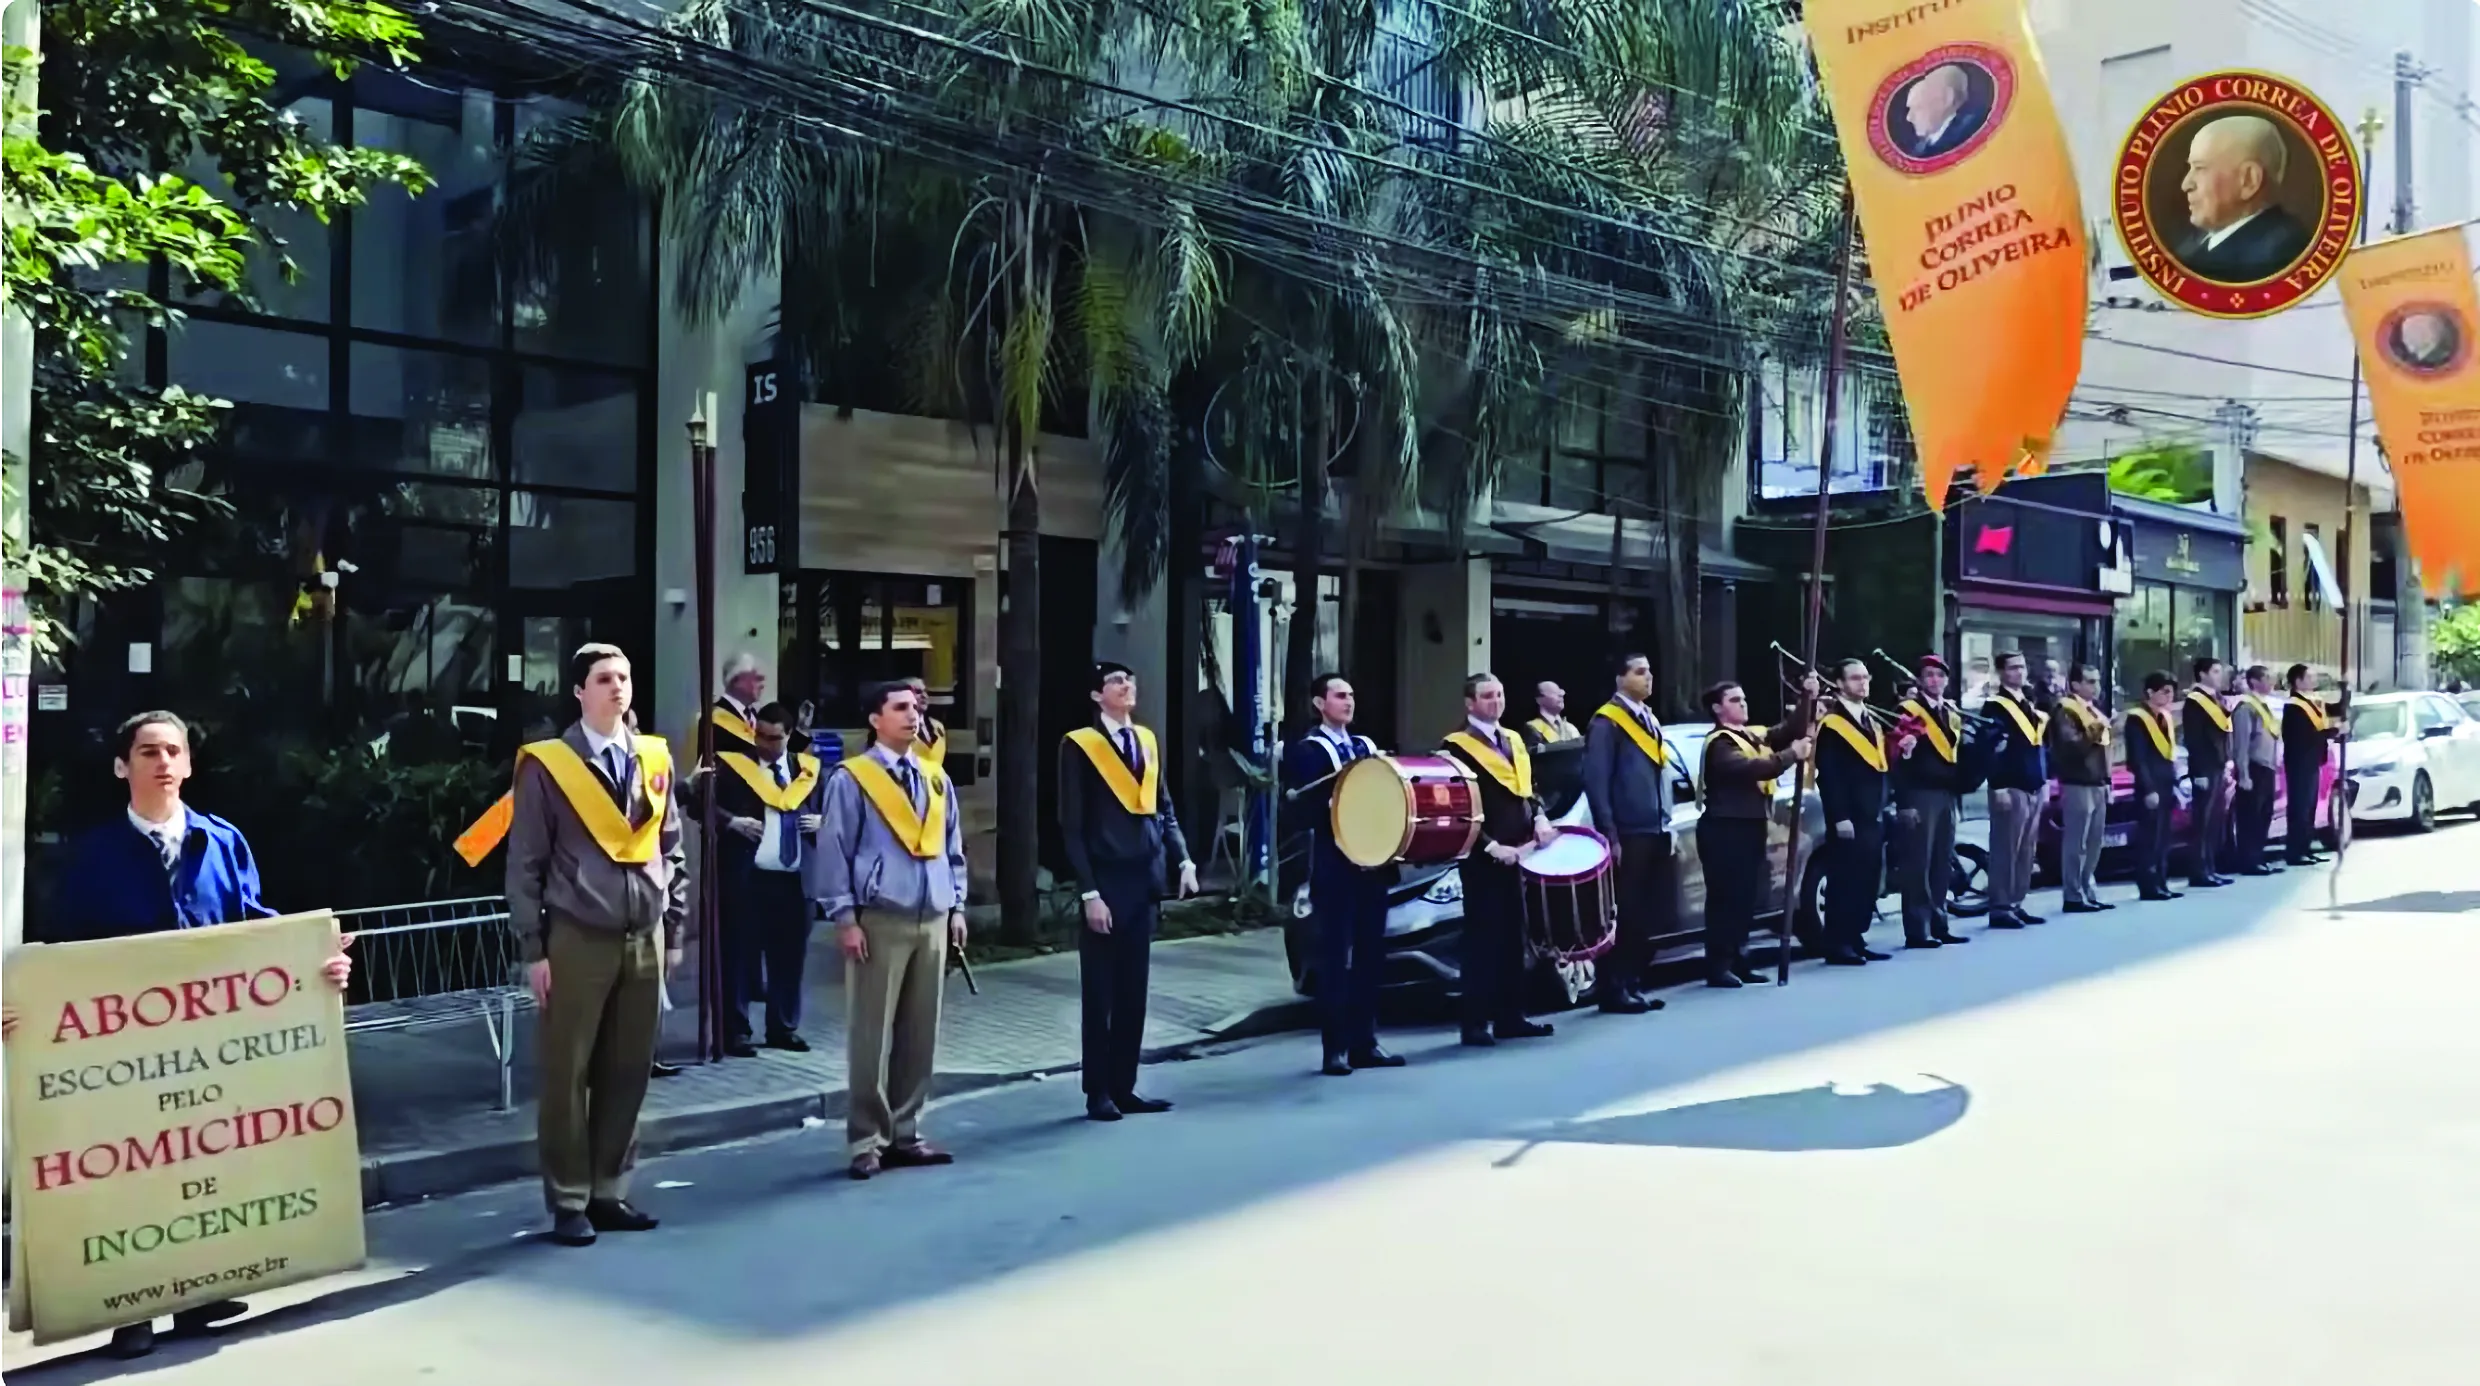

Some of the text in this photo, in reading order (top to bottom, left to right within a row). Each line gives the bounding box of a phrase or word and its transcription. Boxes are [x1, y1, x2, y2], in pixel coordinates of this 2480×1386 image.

[1846, 0, 1962, 44] INSTIT
[1899, 228, 2071, 312] DE OLIVEIRA
[754, 373, 777, 404] IS
[51, 966, 302, 1043] ABORTO:
[38, 1024, 326, 1101] ESCOLHA CRUEL
[159, 1084, 223, 1112] PELO
[31, 1096, 344, 1191] HOMICÍDIO
[182, 1177, 217, 1200] DE
[83, 1188, 318, 1266] INOCENTES
[104, 1256, 289, 1309] wwwipco.org.br
